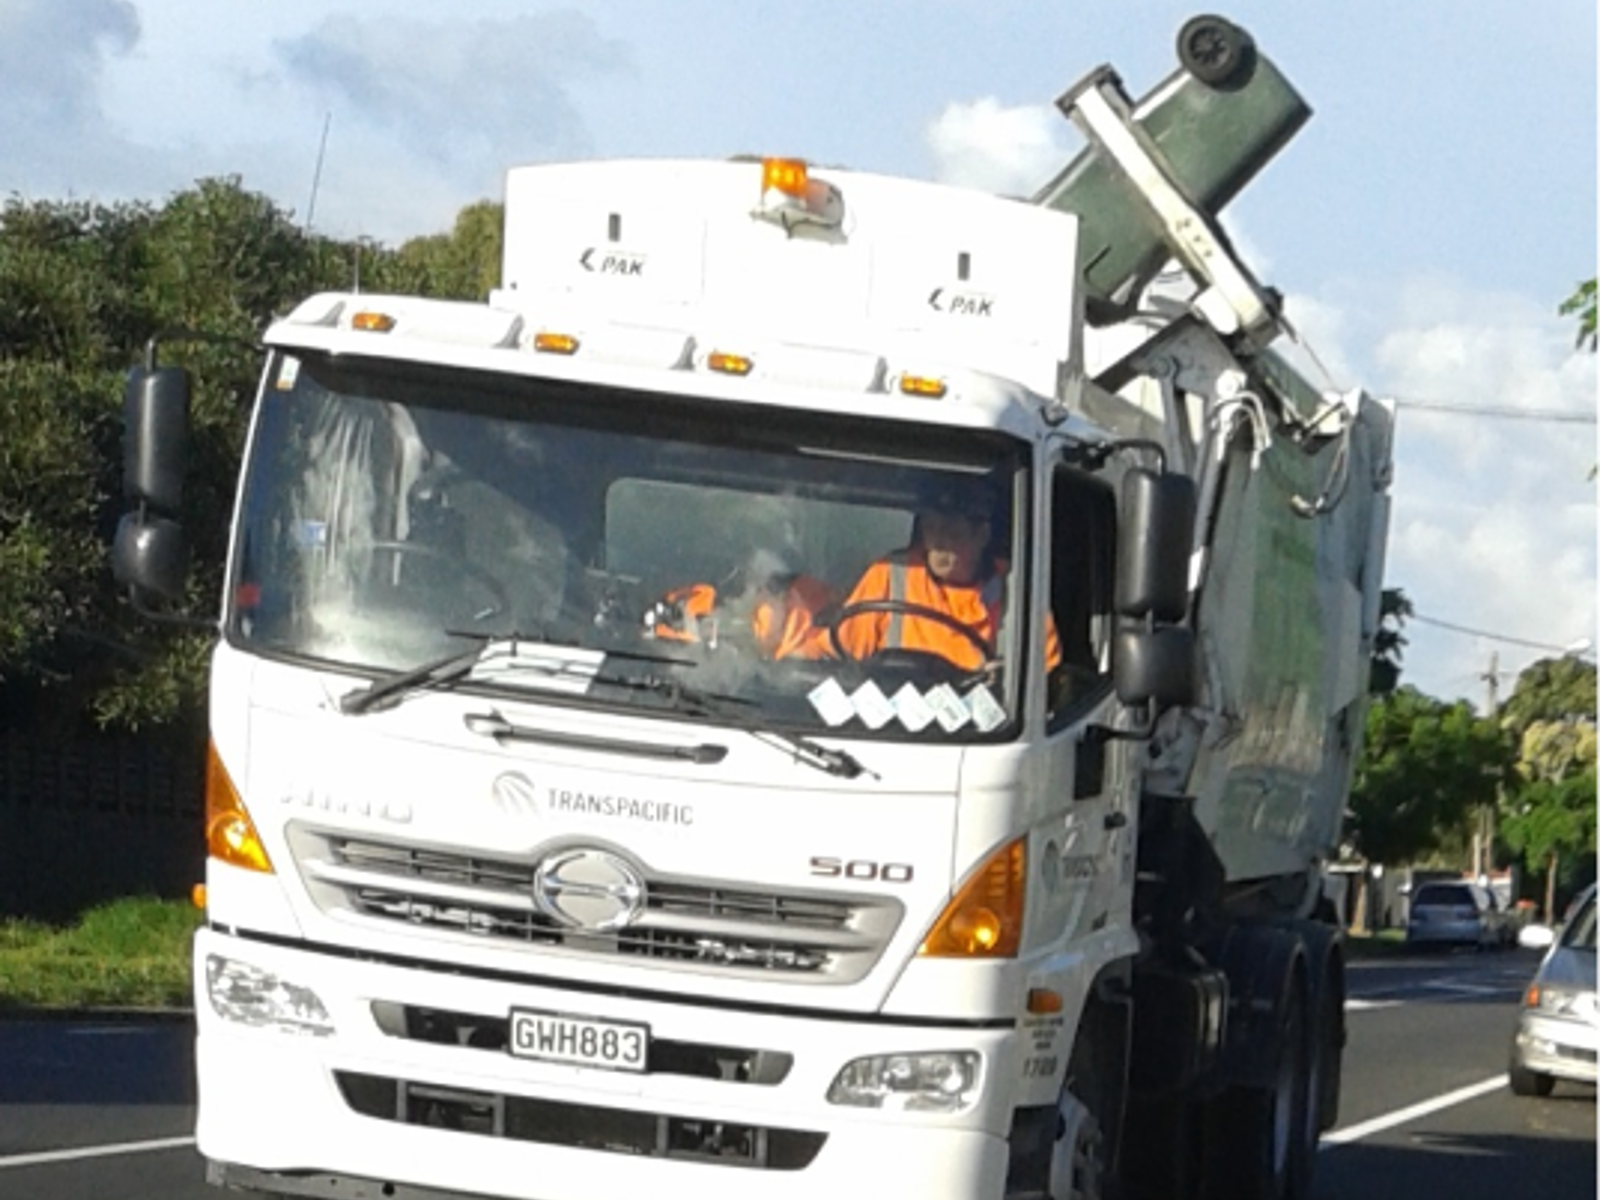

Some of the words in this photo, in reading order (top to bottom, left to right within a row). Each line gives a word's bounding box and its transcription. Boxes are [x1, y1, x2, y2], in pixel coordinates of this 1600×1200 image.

[948, 294, 994, 317] PAK
[547, 787, 694, 827] TRANSPACIFIC
[809, 856, 914, 884] 500
[515, 1016, 642, 1063] GWH883
